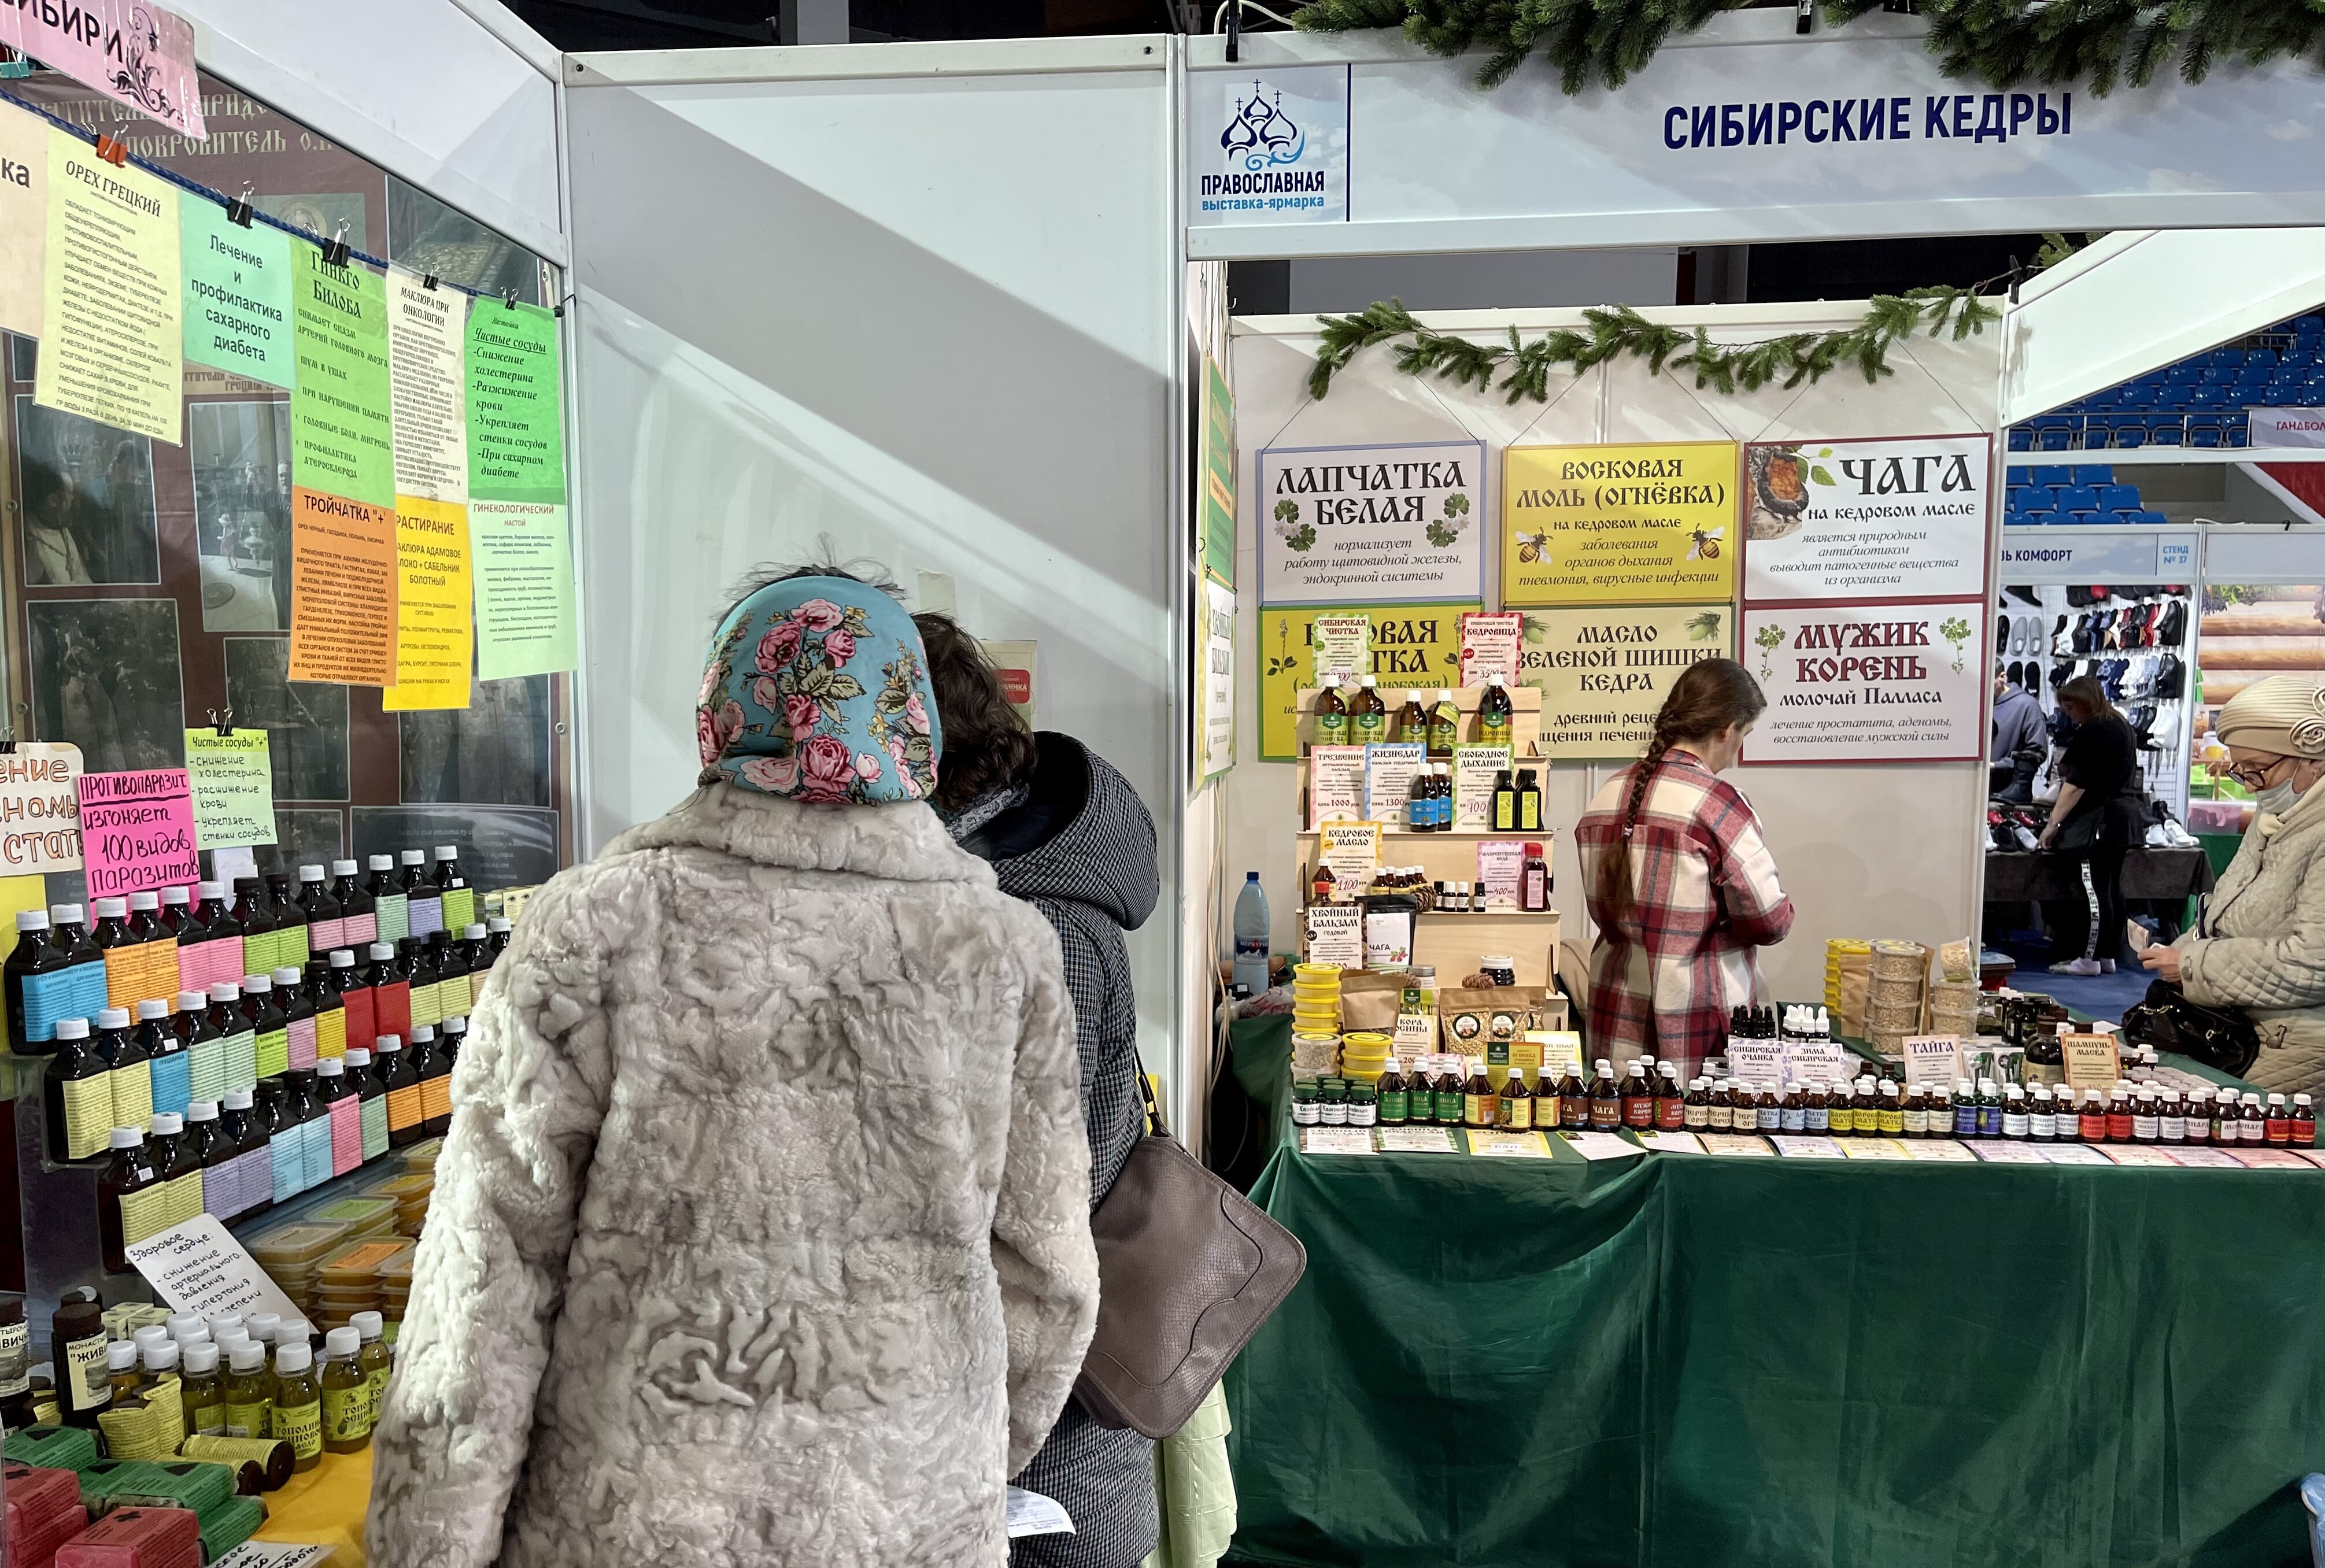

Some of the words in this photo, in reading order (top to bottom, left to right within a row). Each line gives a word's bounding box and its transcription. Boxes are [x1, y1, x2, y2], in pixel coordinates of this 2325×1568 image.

[1664, 96, 1912, 150] СИБИРСКИЕ
[1924, 92, 2071, 144] КЕДРЫ
[66, 160, 101, 188] ОРЕХ
[102, 177, 161, 217] ГРЕЦКИЙ
[1202, 171, 1324, 195] ПРАВОСЛАВНАЯ
[1202, 196, 1324, 211] выставка-ярмарка
[210, 234, 263, 269] Лечение
[93, 261, 112, 273] ОБМЕН
[136, 278, 147, 288] ПРИ
[235, 271, 241, 284] и
[191, 279, 282, 323] профилактика
[313, 279, 361, 319] БИЛОБА
[400, 287, 434, 308] МАКЛЮРА
[436, 300, 449, 313] ПРИ
[298, 308, 331, 329] СНИМАЕТ
[333, 323, 356, 339] СПАЗМ
[403, 304, 445, 327] ОНКОЛОГИИ
[206, 308, 271, 341] сахарного
[214, 335, 265, 362] диабета
[298, 324, 328, 345] АРТЕРИЙ
[331, 339, 365, 358] ГОЛОВНОГО
[367, 353, 389, 368] МОЗГА
[474, 328, 511, 347] Чистые
[512, 337, 547, 354] сосуды
[473, 347, 525, 367] -Снижение
[301, 356, 318, 369] ШУМ
[321, 364, 325, 372] В
[327, 365, 347, 380] УШАХ
[474, 366, 534, 384] холестерина
[472, 382, 537, 401] -Разжижение
[302, 386, 316, 399] ПРИ
[319, 391, 360, 413] НАРУШЕНИИ
[362, 406, 390, 424] ПАМЯТИ
[475, 398, 503, 412] крови
[303, 414, 339, 434] ГОЛОВНЫЕ
[360, 434, 390, 451] МИГРЕНЬ
[475, 416, 529, 432] -Укрепляет
[479, 433, 513, 448] стенки
[515, 437, 548, 450] сосудов
[304, 439, 357, 464] ПРОФИЛАКТИКА
[477, 449, 500, 462] -При
[502, 452, 544, 466] сахарном
[304, 457, 358, 479] АТЕРОСКЛЕРОЗА
[481, 465, 520, 479] диабете
[1561, 460, 1683, 480] ВОСКОВАЯ
[1839, 454, 1976, 495] ЧАГА
[1276, 460, 1466, 494] ЛАПЧАТКА
[1517, 489, 1585, 508] МОЛЬ
[1595, 482, 1725, 511] (ОГНЁВКА)
[304, 494, 371, 523] ТРОЙЧАТКА
[474, 503, 555, 515] ГИНЕКОЛОГИЧЕСКИЙ
[1315, 495, 1426, 525] БЕЛАЯ
[1809, 508, 1828, 520] на
[395, 515, 454, 536] РАСТИРАНИЕ
[504, 519, 526, 527] НАСТОЙ
[1554, 521, 1569, 530] на
[1580, 539, 1658, 550] заболевания
[1802, 532, 1855, 544] является
[1859, 529, 1926, 545] природным
[397, 542, 425, 554] АКЛЮРА
[426, 547, 461, 559] АДАМОВОЕ
[1334, 539, 1412, 553] нормализует
[1818, 544, 1909, 557] антибиотиком
[2163, 545, 2189, 554] СТЕНД
[1284, 557, 1329, 572] работу
[1332, 554, 1409, 569] щитовидной
[1411, 554, 1462, 565] железы,
[1565, 556, 1615, 568] органов
[1618, 554, 1673, 567] дыхания
[2016, 549, 2072, 562] КОМФОРТ
[2179, 556, 2187, 564] 37
[424, 561, 460, 574] САБЕЛЬНИК
[1769, 561, 1821, 572] выводит
[1824, 560, 1897, 572] патогенные
[1899, 559, 1958, 570] вещества
[409, 574, 446, 586] БОЛОТНЫЙ
[1303, 571, 1378, 586] эндокринной
[1381, 571, 1444, 582] сиситемы
[1519, 574, 1588, 586] пневмония,
[1593, 574, 1653, 587] вирусные
[1656, 569, 1718, 585] инфекции
[1825, 576, 1837, 586] из
[1839, 575, 1901, 588] организма
[1467, 628, 1516, 637] КЕДРОВИЦА
[1577, 625, 1658, 644] МАСЛО
[1794, 621, 1930, 656] МУЖИК
[1796, 655, 1927, 683] КОРЕНЬ
[1579, 673, 1654, 694] КЕДРА
[1780, 690, 1855, 707] молочай
[1863, 687, 1942, 705] Палласа
[1770, 721, 1814, 730] лечение
[1817, 718, 1895, 731] простатита,
[1898, 716, 1952, 728] аденомы,
[193, 737, 224, 748] Чистые
[225, 738, 253, 748] сосуды
[1773, 733, 1864, 744] восстановление
[1865, 730, 1919, 745] мужской
[1921, 731, 1949, 742] силы
[196, 756, 245, 767] снижение
[1372, 750, 1421, 759] ЖИЗНЕДАР
[1458, 750, 1509, 759] СВОБОДНОЕ
[1461, 760, 1506, 768] ДЫХАНИЕ
[198, 769, 265, 779] холестерина
[200, 799, 227, 809] крови
[1331, 799, 1350, 807] 1000
[1385, 798, 1404, 807] 1300
[84, 807, 172, 831] изгоняет
[201, 816, 256, 828] укрепляет
[202, 831, 235, 842] стенки
[237, 826, 271, 838] сосудов
[1328, 830, 1375, 838] КЕДРОВОЕ
[102, 834, 133, 864] 100
[137, 828, 191, 857] видов
[1337, 879, 1358, 890] 1100
[1311, 908, 1359, 917] ХВОЙНЫЙ
[1313, 919, 1358, 927] БАЛЬЗАМ
[1733, 1046, 1781, 1054] СИБИРСКАЯ
[1909, 1040, 1954, 1055] ТАЙГА
[1592, 1105, 1614, 1115] ЧАГА
[163, 1249, 221, 1281] снижение
[179, 1274, 226, 1300] давления
[191, 1277, 251, 1312] гипертония
